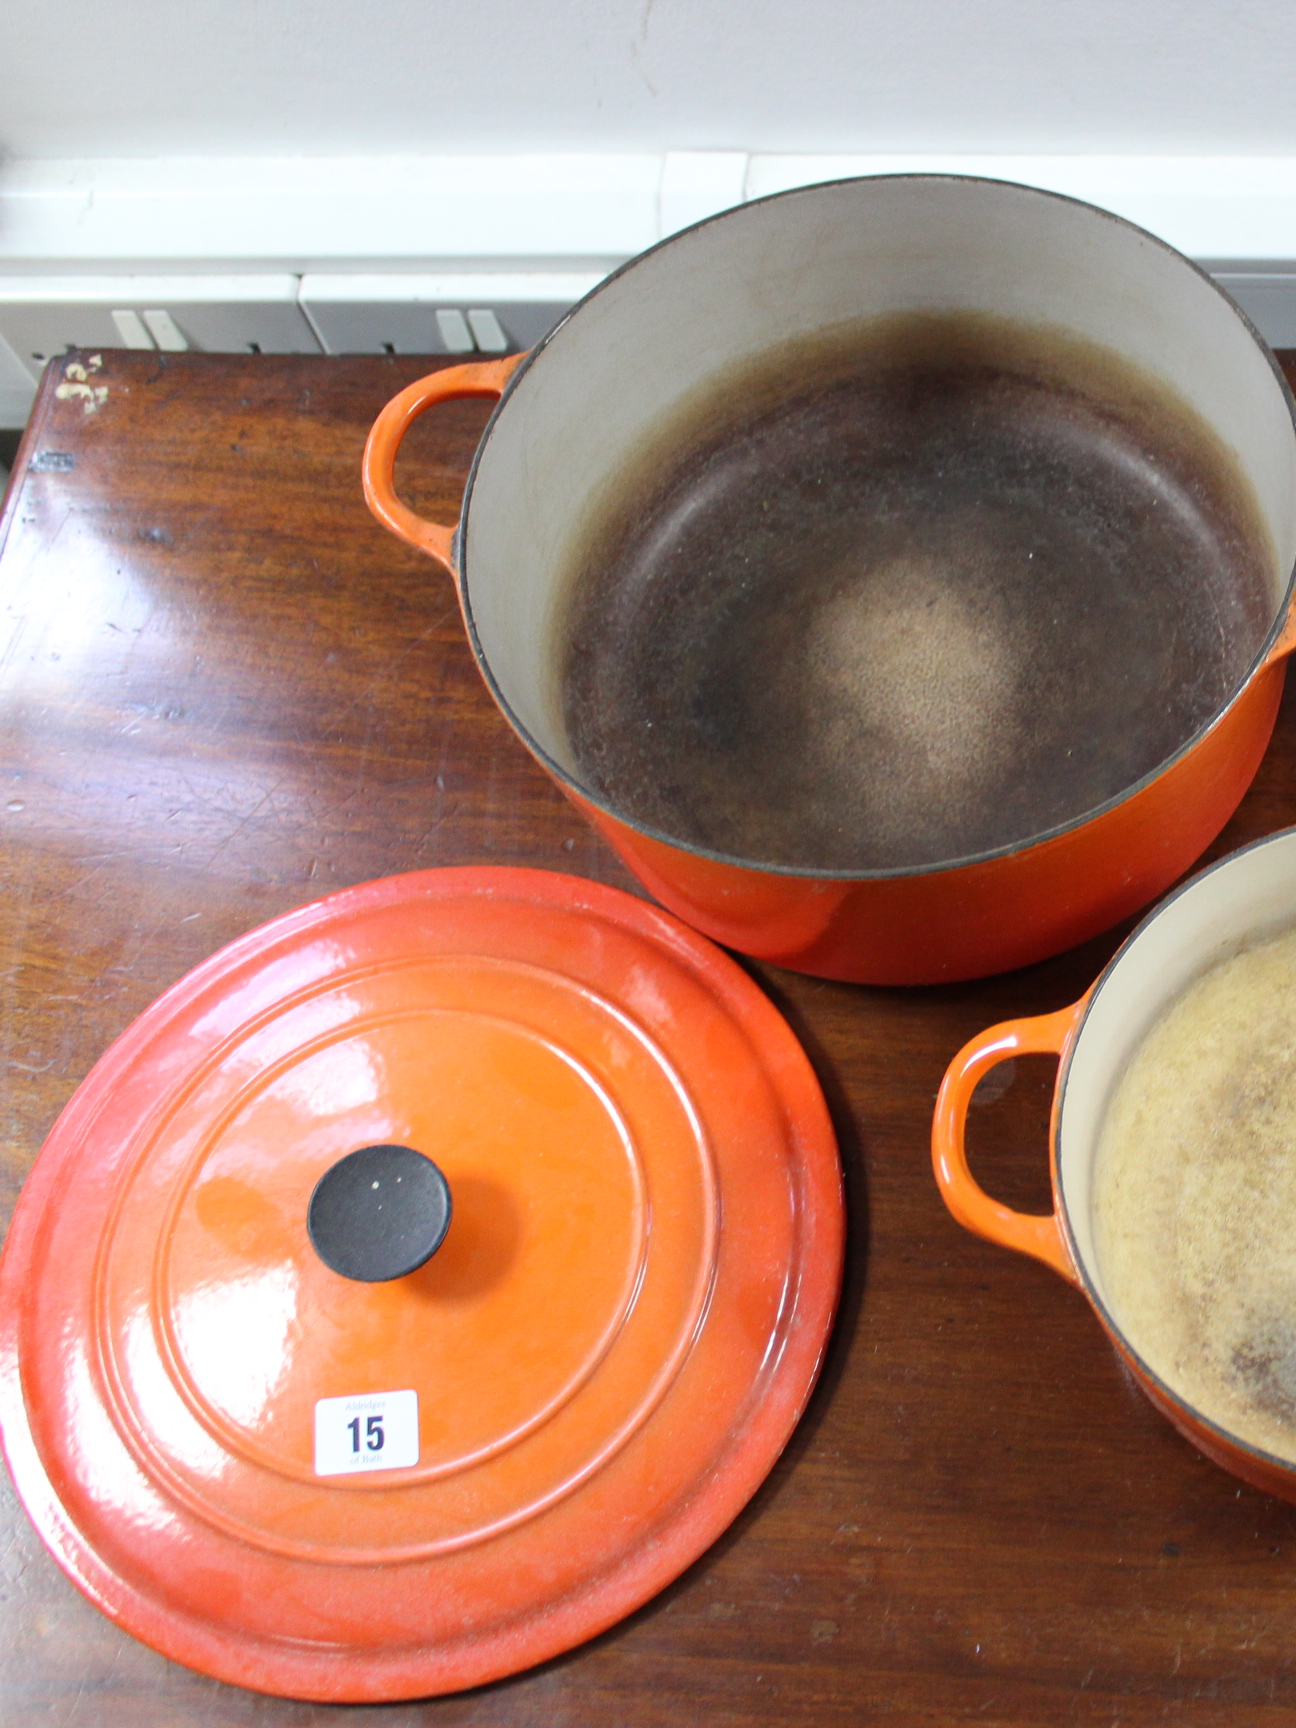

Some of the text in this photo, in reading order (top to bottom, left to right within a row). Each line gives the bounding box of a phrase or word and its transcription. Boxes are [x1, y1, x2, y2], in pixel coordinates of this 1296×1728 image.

[345, 1400, 386, 1412] Aldridges
[347, 1415, 385, 1453] 15
[349, 1453, 383, 1465] of Bath
